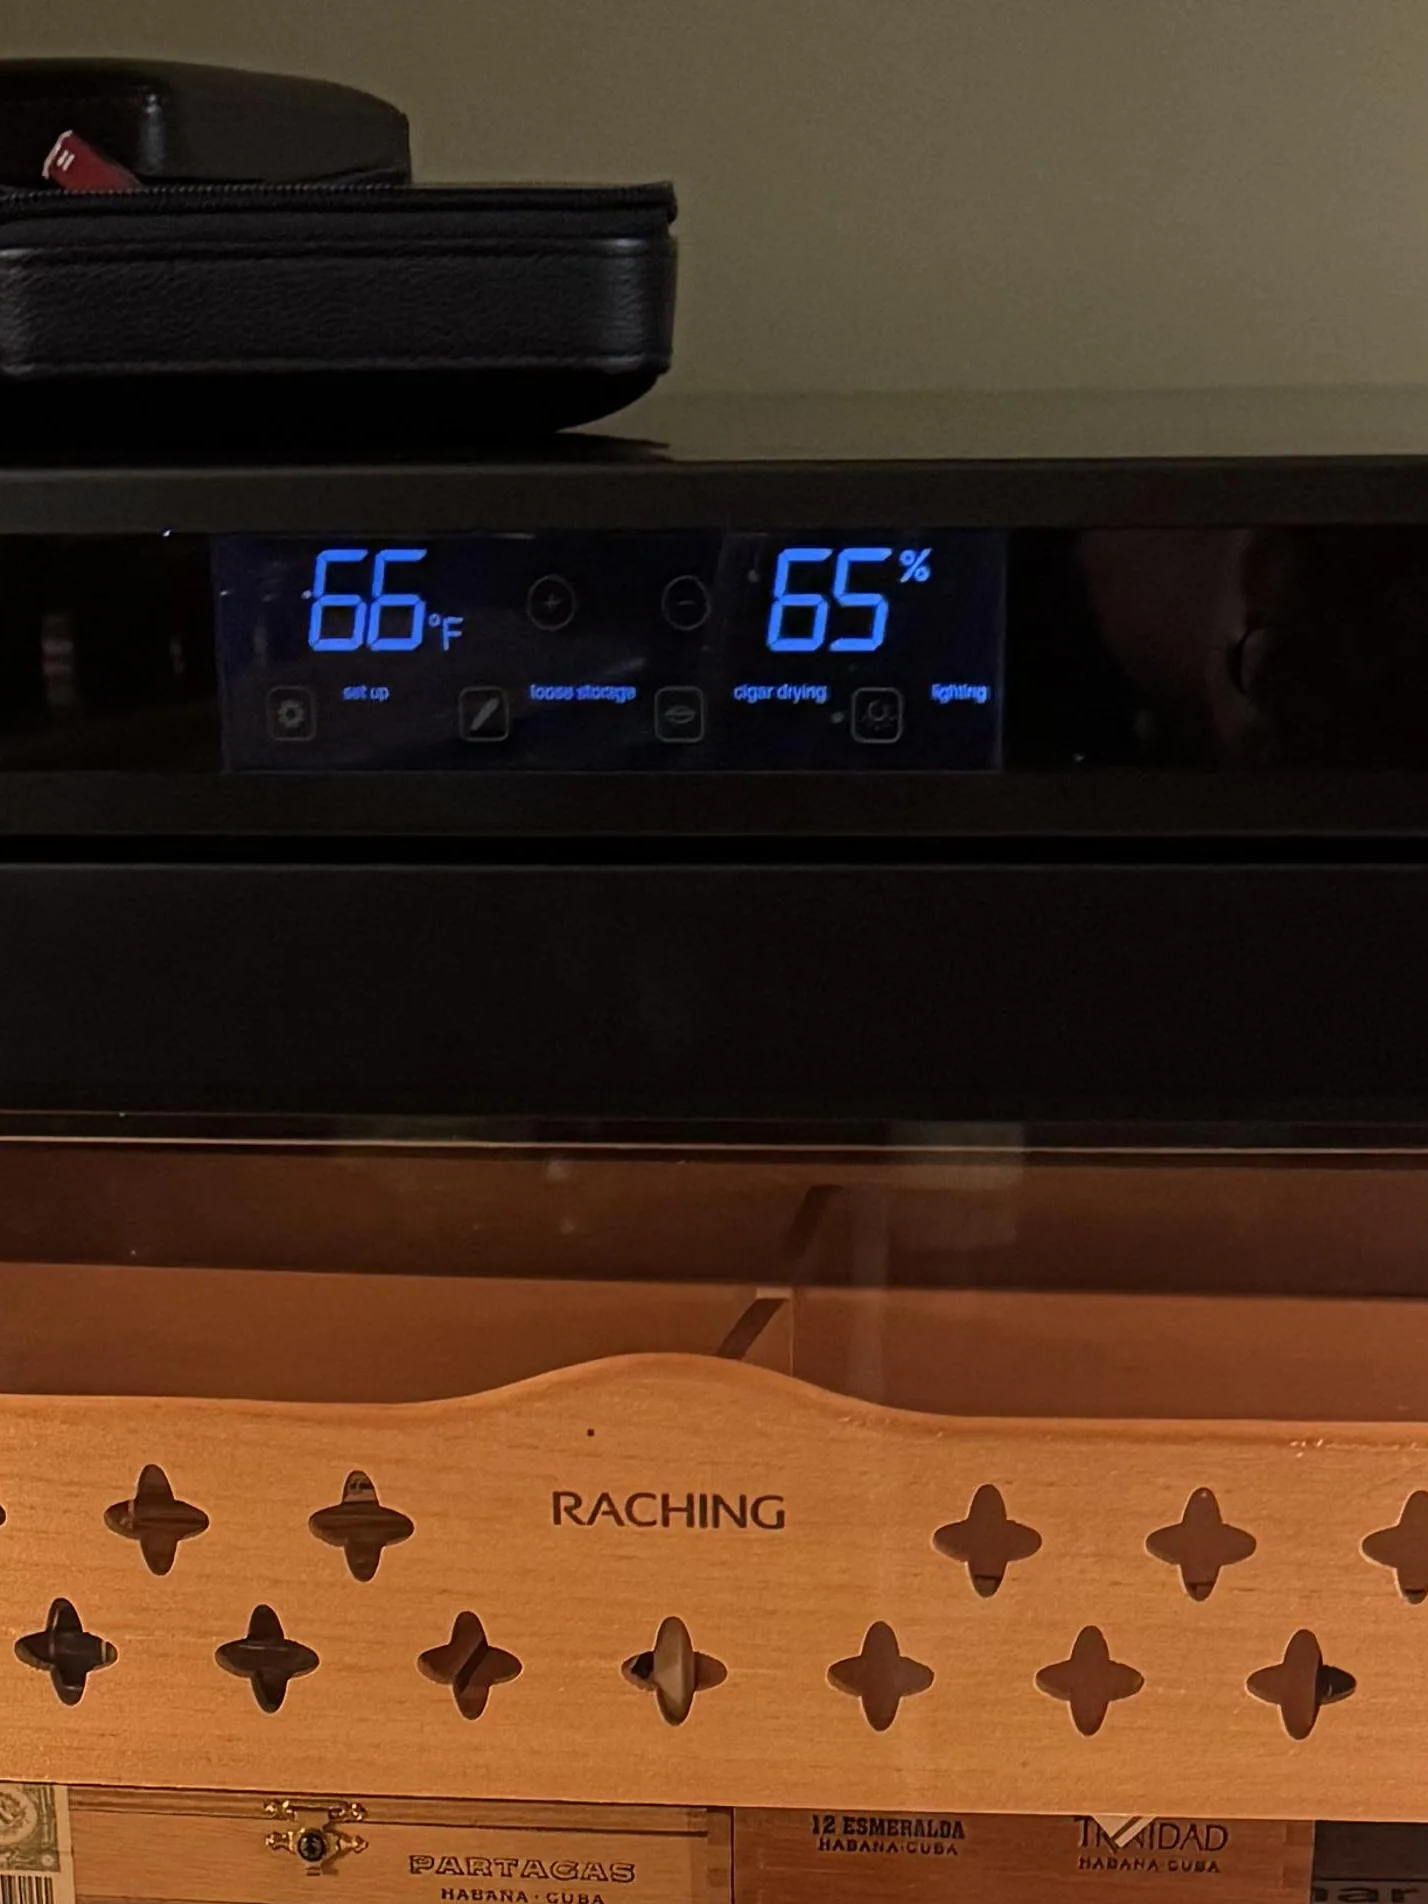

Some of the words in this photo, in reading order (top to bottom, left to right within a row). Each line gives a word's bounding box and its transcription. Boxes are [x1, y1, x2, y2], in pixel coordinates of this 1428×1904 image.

[343, 685, 368, 701] set
[529, 684, 574, 701] loose
[576, 684, 637, 703] storage
[734, 684, 774, 703] cigar
[776, 684, 828, 703] drying
[932, 684, 989, 703] lighting
[552, 1491, 785, 1530] RACHING
[811, 1815, 836, 1835] 12
[842, 1816, 966, 1840] ESMERALDA
[408, 1854, 636, 1884] PARTAGAS
[441, 1887, 528, 1903] HABANA
